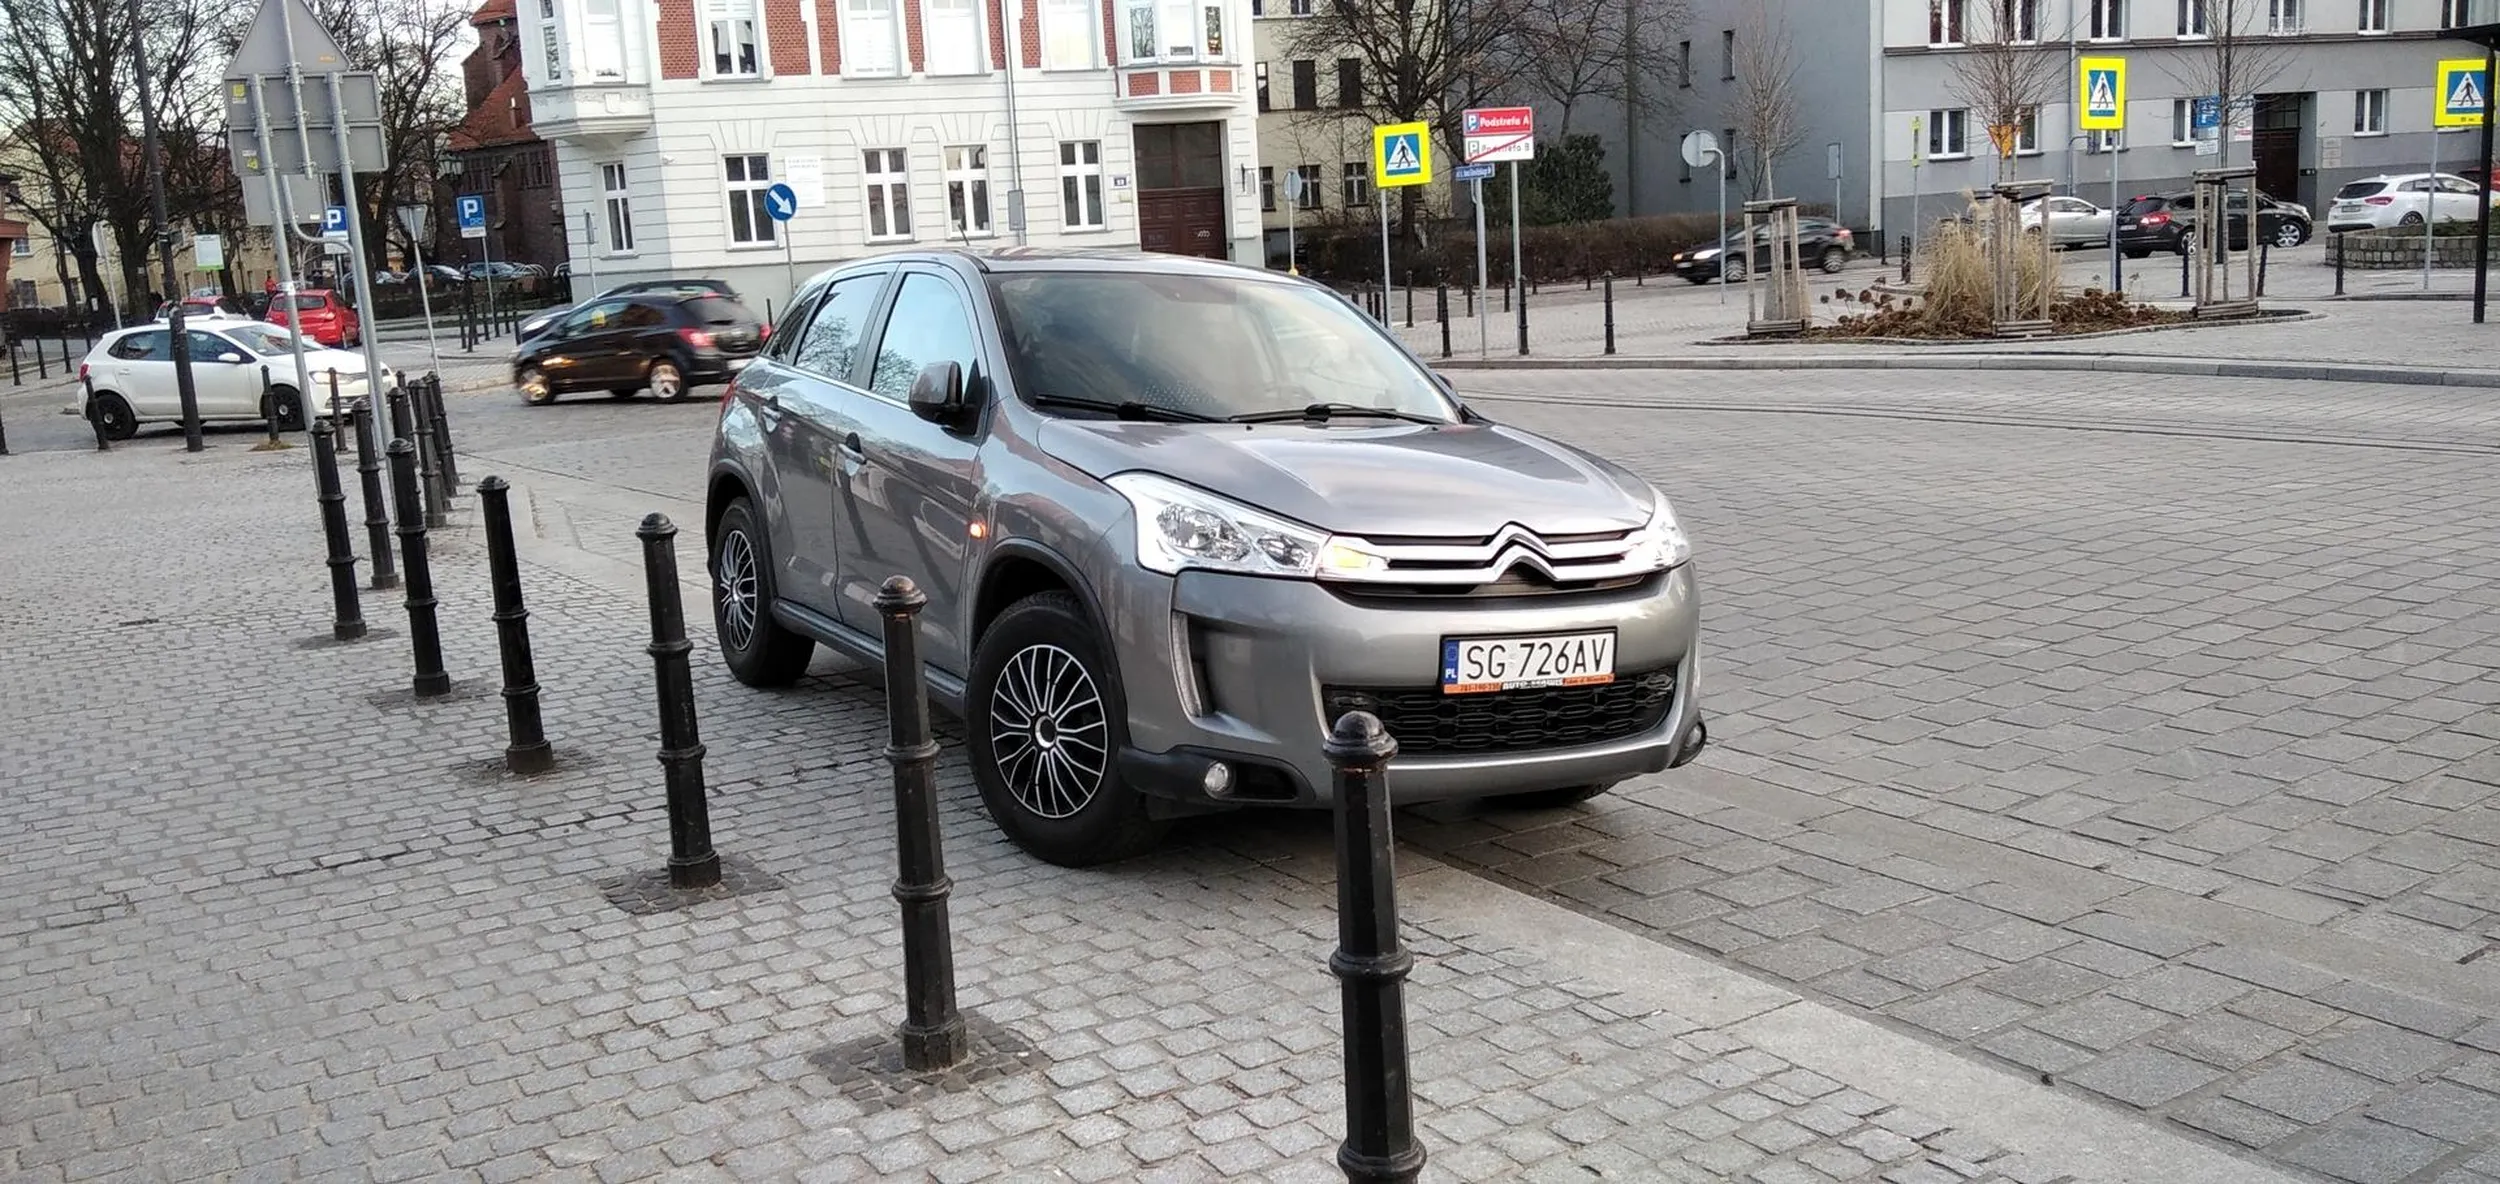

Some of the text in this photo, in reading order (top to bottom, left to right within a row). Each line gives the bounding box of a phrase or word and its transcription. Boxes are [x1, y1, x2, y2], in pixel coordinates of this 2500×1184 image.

[1480, 116, 1521, 127] Podstrefa
[1523, 114, 1530, 125] A
[1524, 142, 1530, 151] B
[463, 199, 479, 219] P
[326, 209, 342, 229] P
[1467, 637, 1607, 680] SG 726AV
[1445, 668, 1457, 679] PL
